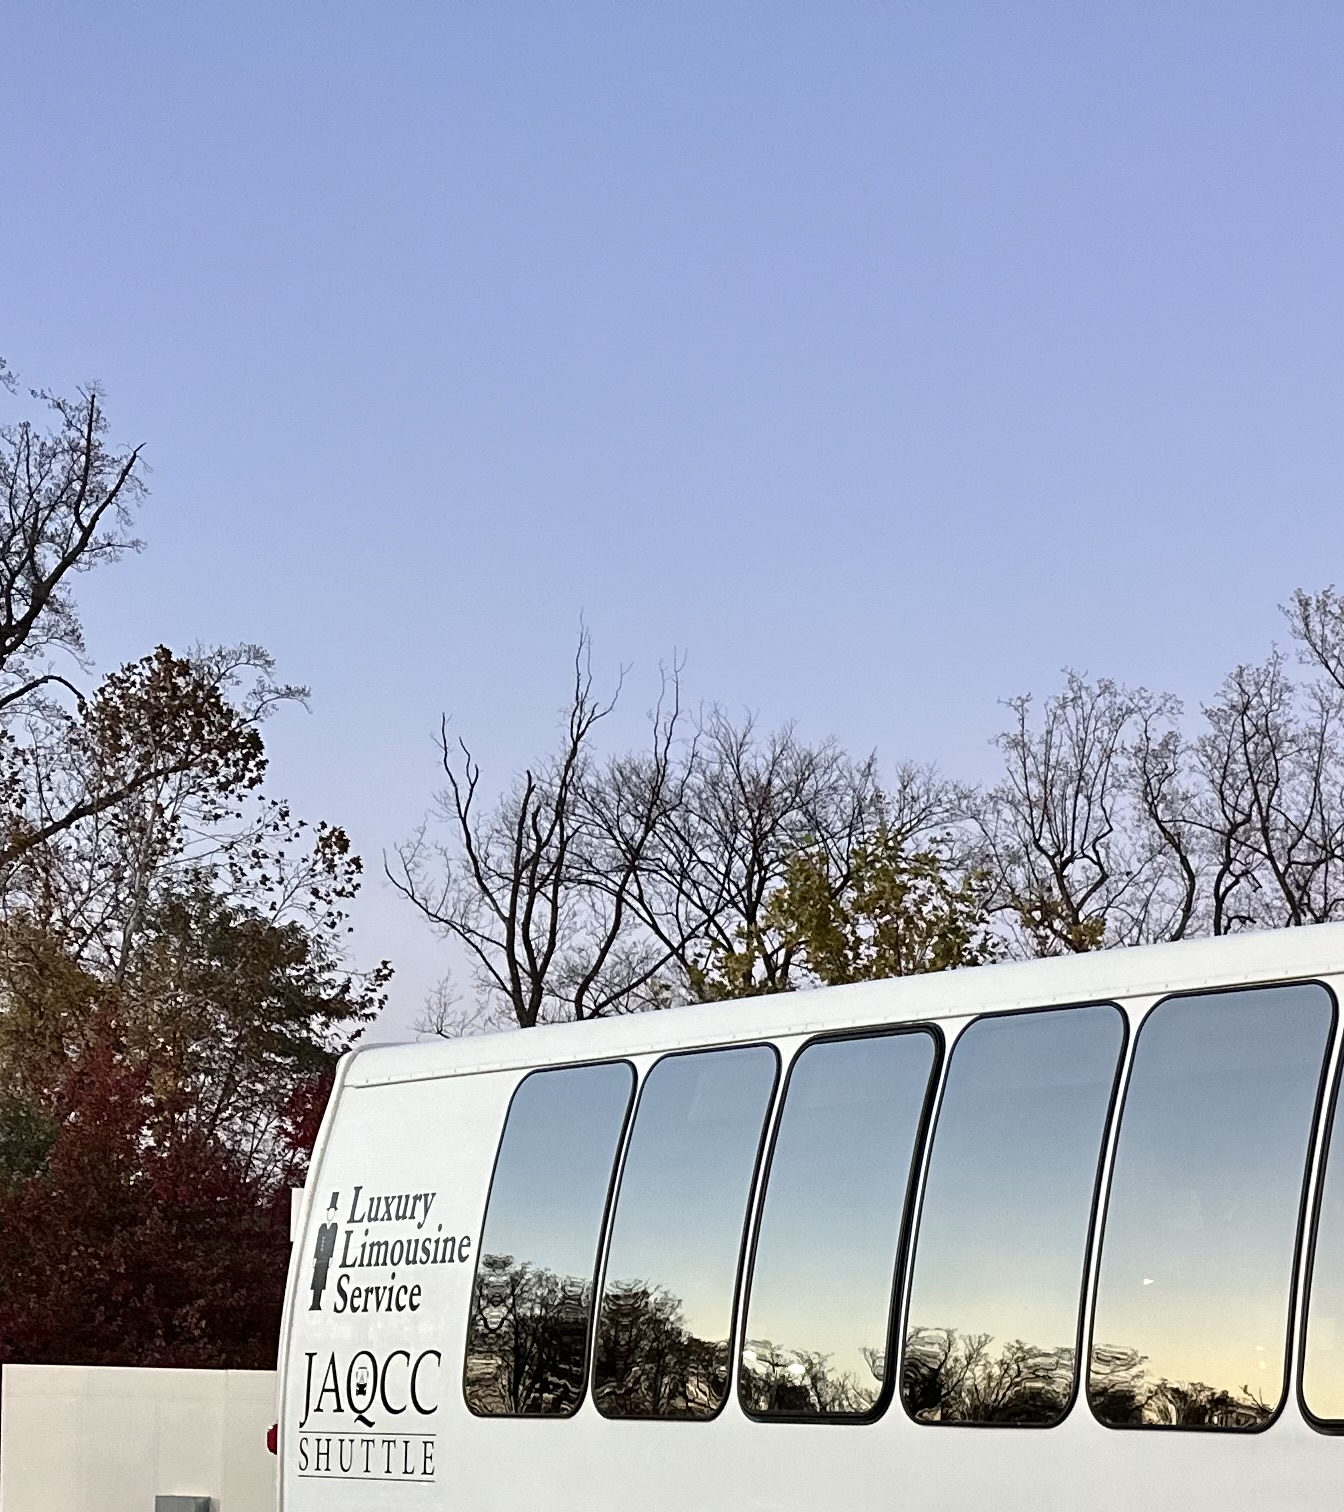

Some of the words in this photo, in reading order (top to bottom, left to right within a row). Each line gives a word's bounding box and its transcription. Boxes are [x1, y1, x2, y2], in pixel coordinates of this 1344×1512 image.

[347, 1186, 437, 1229] Luxury
[339, 1223, 471, 1269] Limousine
[333, 1273, 422, 1314] Service
[299, 1350, 442, 1428] JAQCC
[299, 1437, 435, 1476] SHUTTLE
